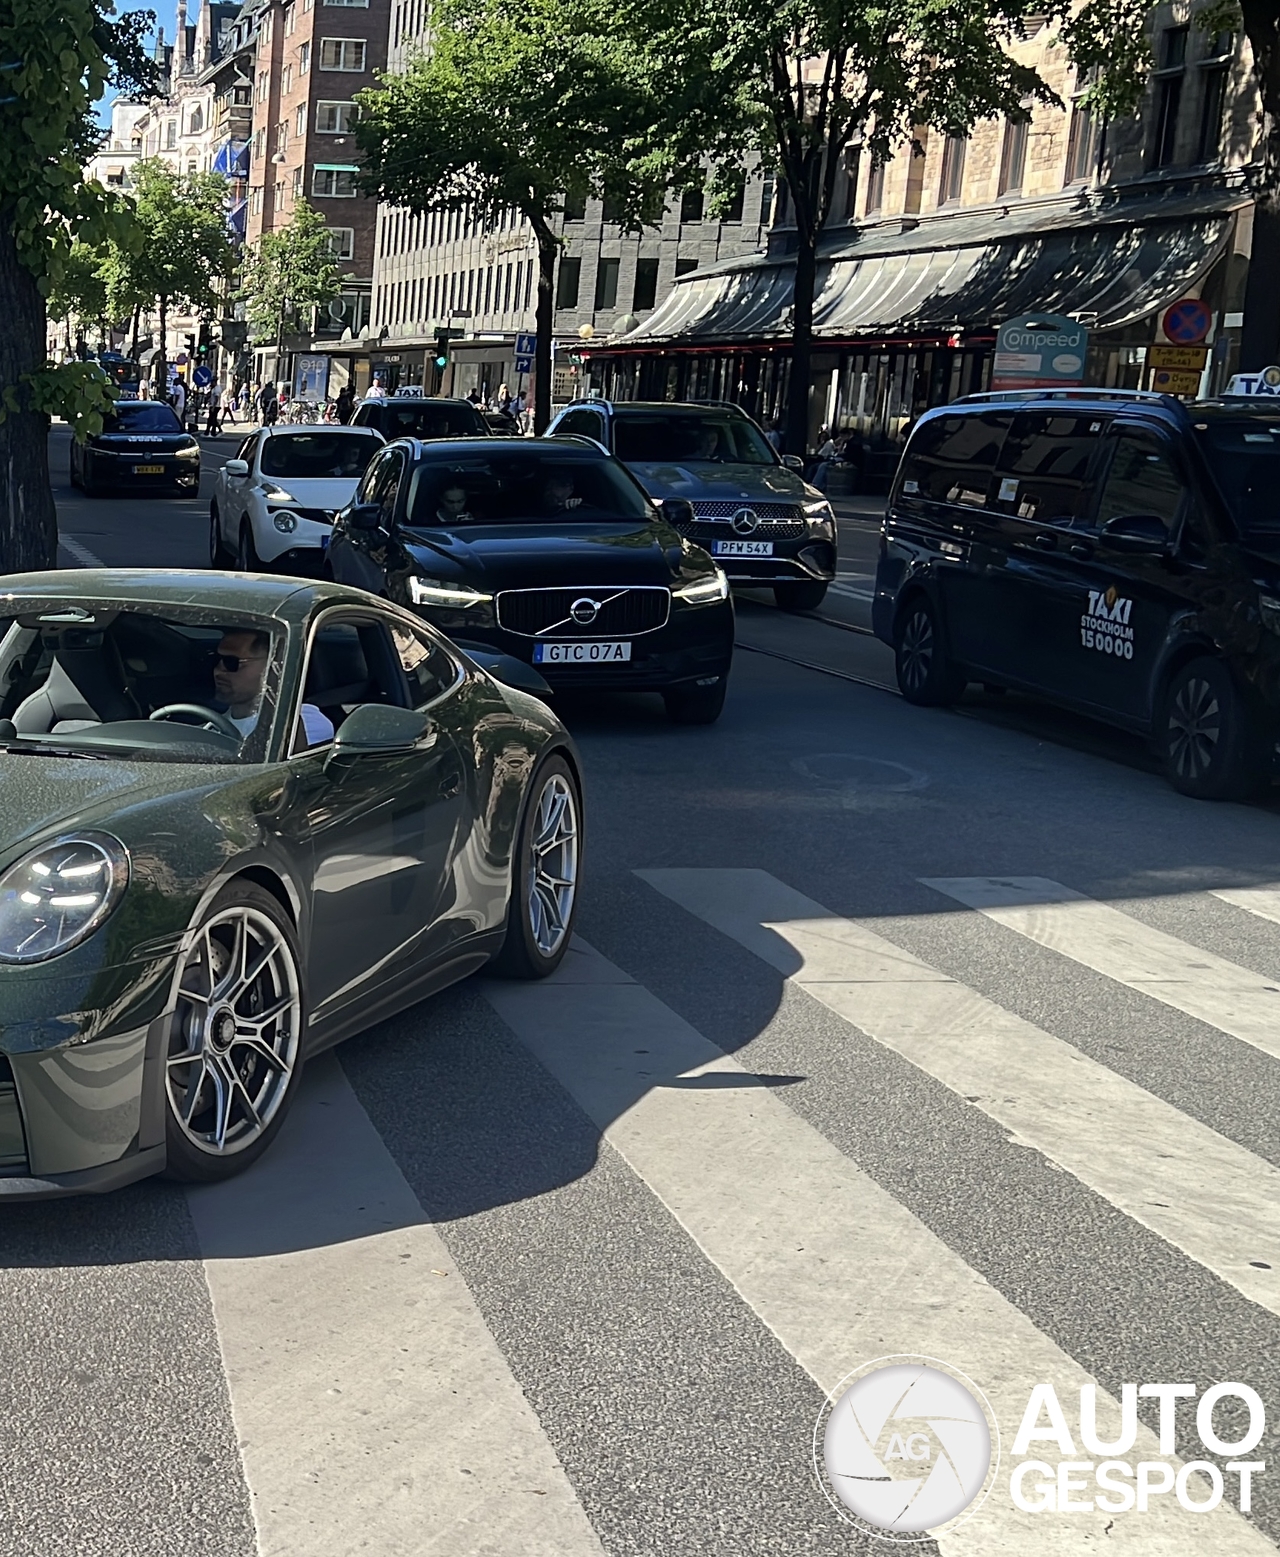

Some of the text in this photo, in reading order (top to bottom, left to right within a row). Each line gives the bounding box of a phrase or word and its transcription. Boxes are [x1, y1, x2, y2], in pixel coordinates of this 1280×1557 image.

[1002, 327, 1081, 351] Compeed
[397, 389, 423, 397] TAXI
[1240, 377, 1280, 395] TA
[721, 542, 769, 554] PFW 54X
[1088, 589, 1133, 625] TAXI
[1081, 615, 1134, 641] STOCKHOLM
[549, 644, 624, 661] GTC 07A
